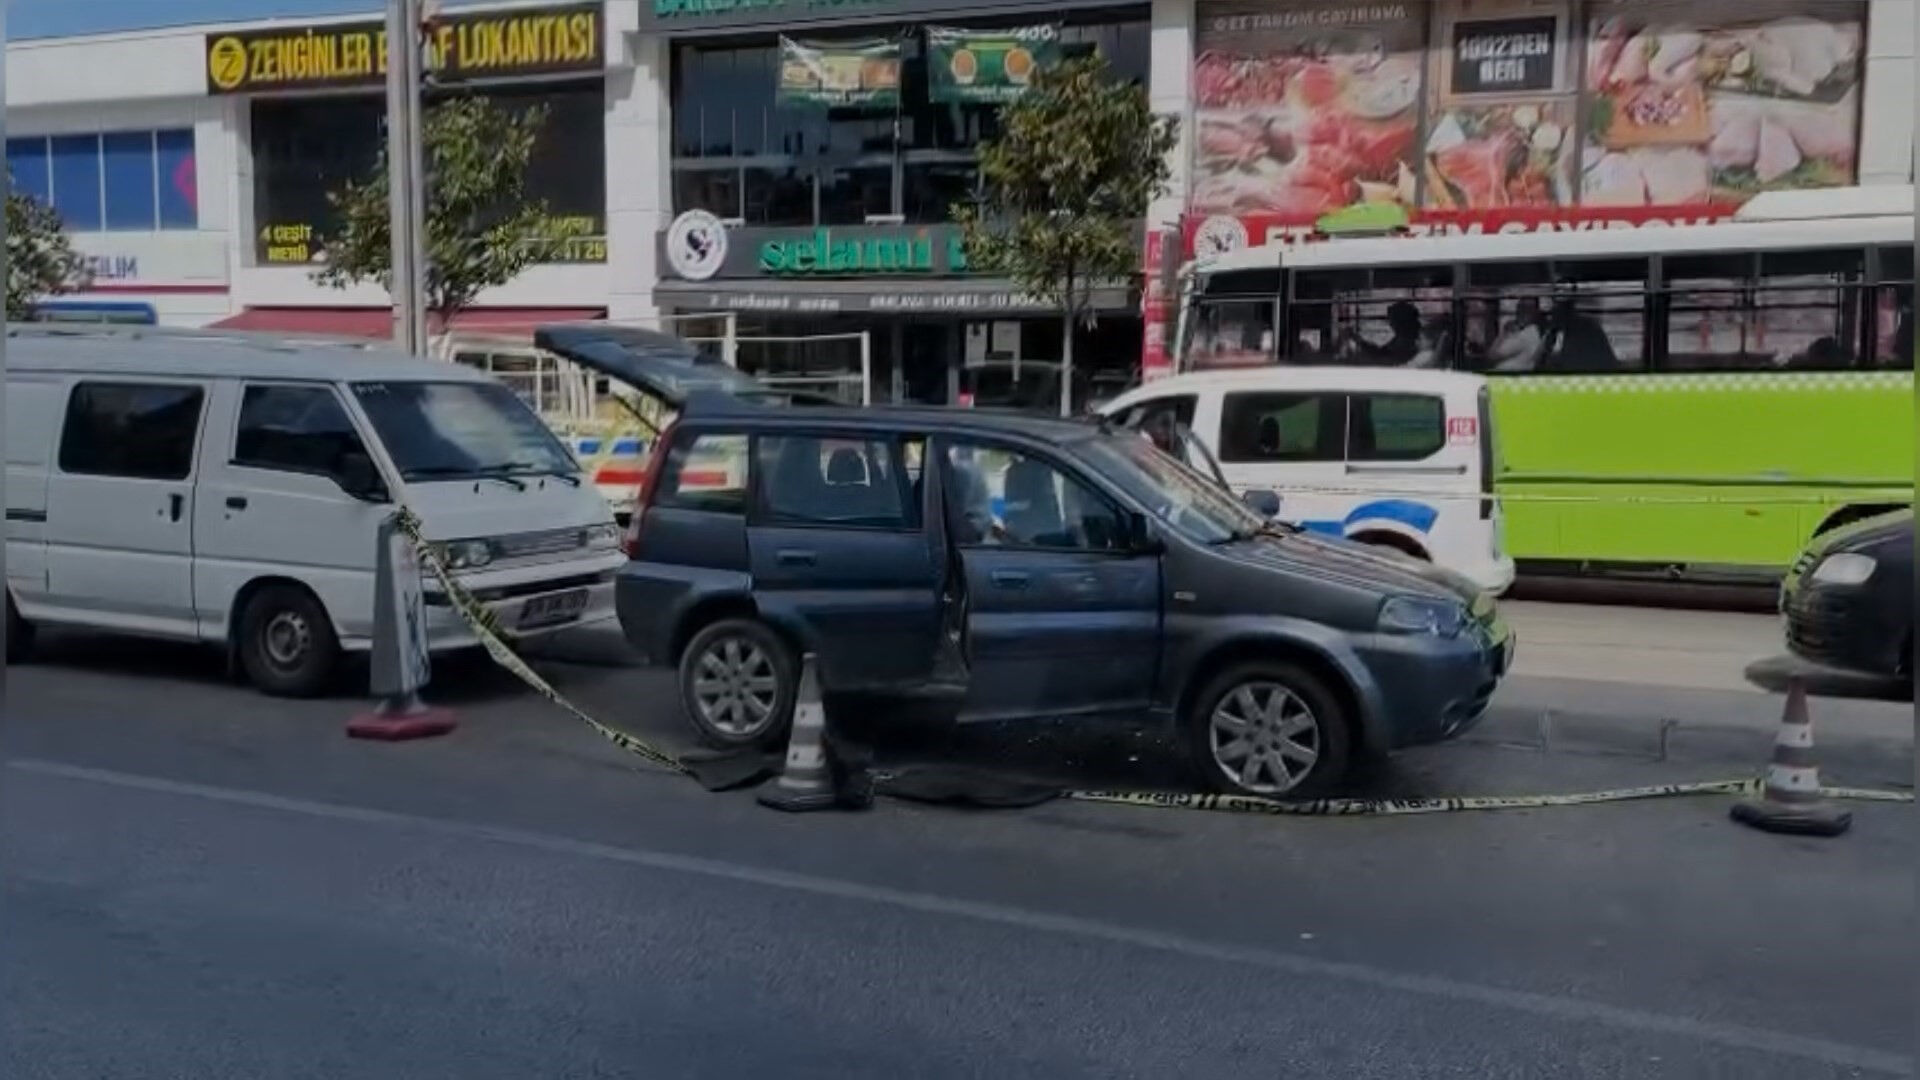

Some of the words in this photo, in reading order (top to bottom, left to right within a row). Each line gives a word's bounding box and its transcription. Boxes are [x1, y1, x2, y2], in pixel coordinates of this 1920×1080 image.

[248, 28, 371, 82] ZENGİNLER
[457, 12, 595, 70] LOKANTASI
[756, 225, 933, 272] selami
